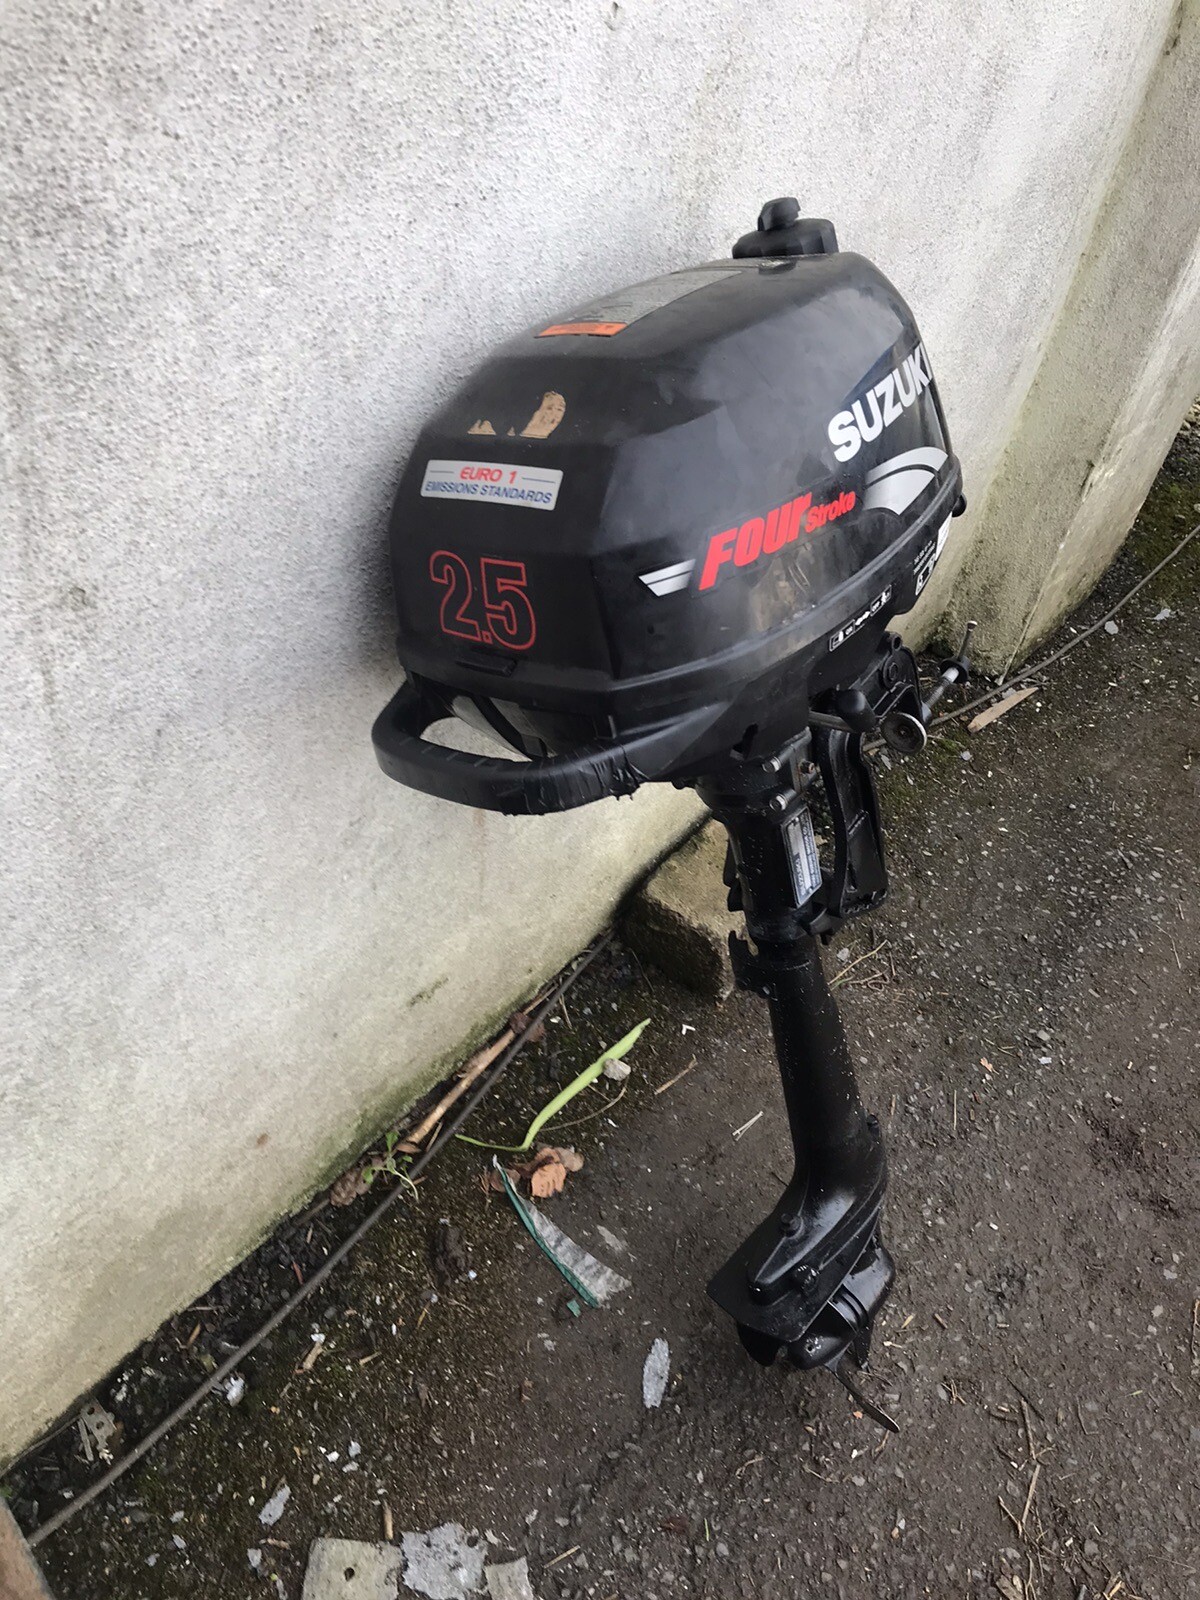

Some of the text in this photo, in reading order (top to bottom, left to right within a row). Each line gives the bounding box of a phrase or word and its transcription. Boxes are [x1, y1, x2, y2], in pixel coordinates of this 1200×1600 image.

[828, 342, 933, 462] SUZUKI
[425, 480, 553, 504] EMISSIONS STANDARDS
[459, 467, 518, 485] EURO 1
[805, 491, 856, 533] Stroke
[429, 550, 536, 650] 2.5
